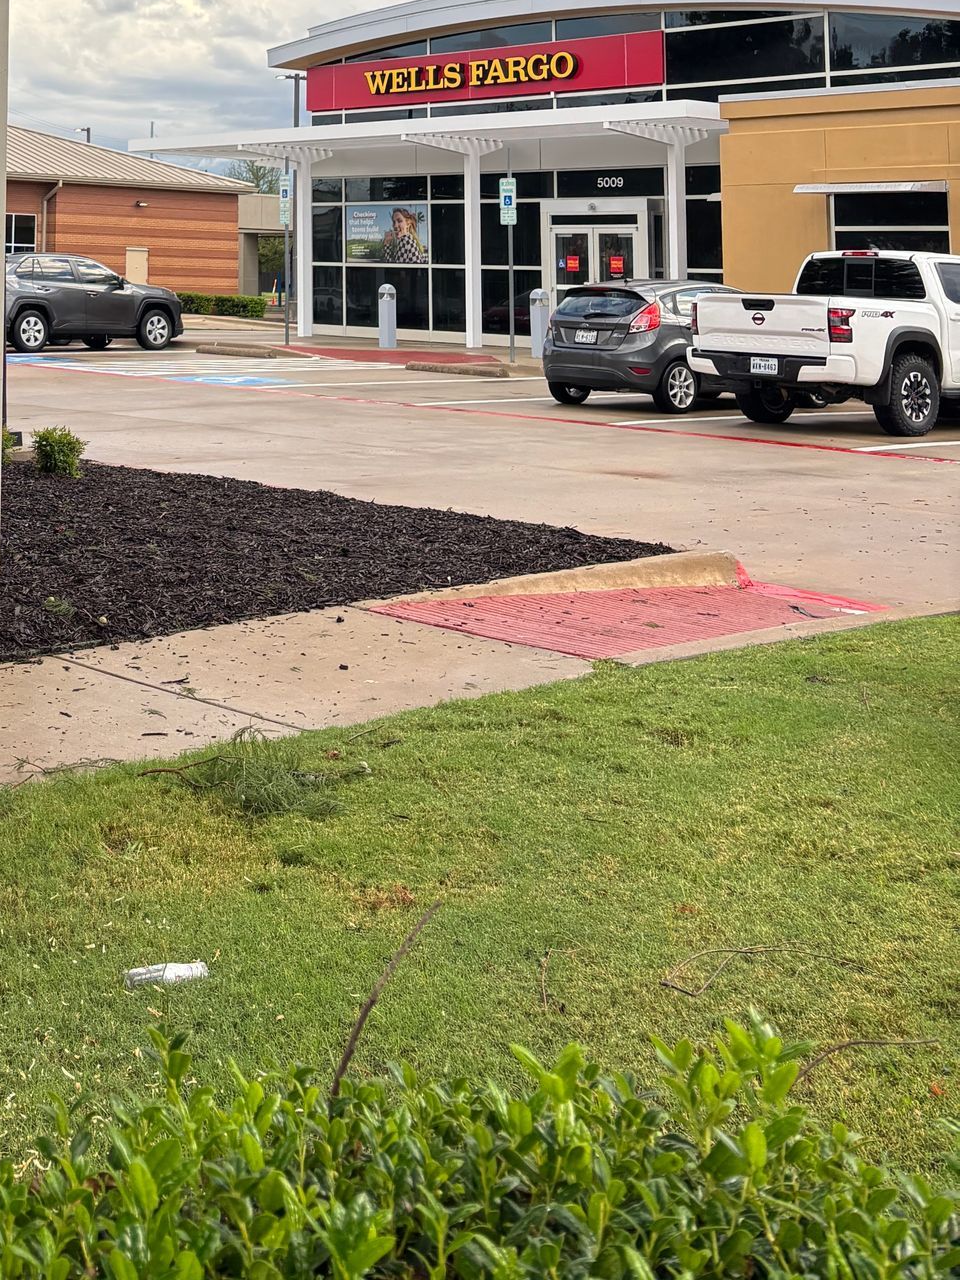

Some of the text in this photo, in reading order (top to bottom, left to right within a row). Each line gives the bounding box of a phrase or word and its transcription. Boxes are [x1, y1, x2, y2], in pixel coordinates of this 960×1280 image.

[364, 52, 576, 95] WELLS FARGO
[597, 177, 624, 188] 5009
